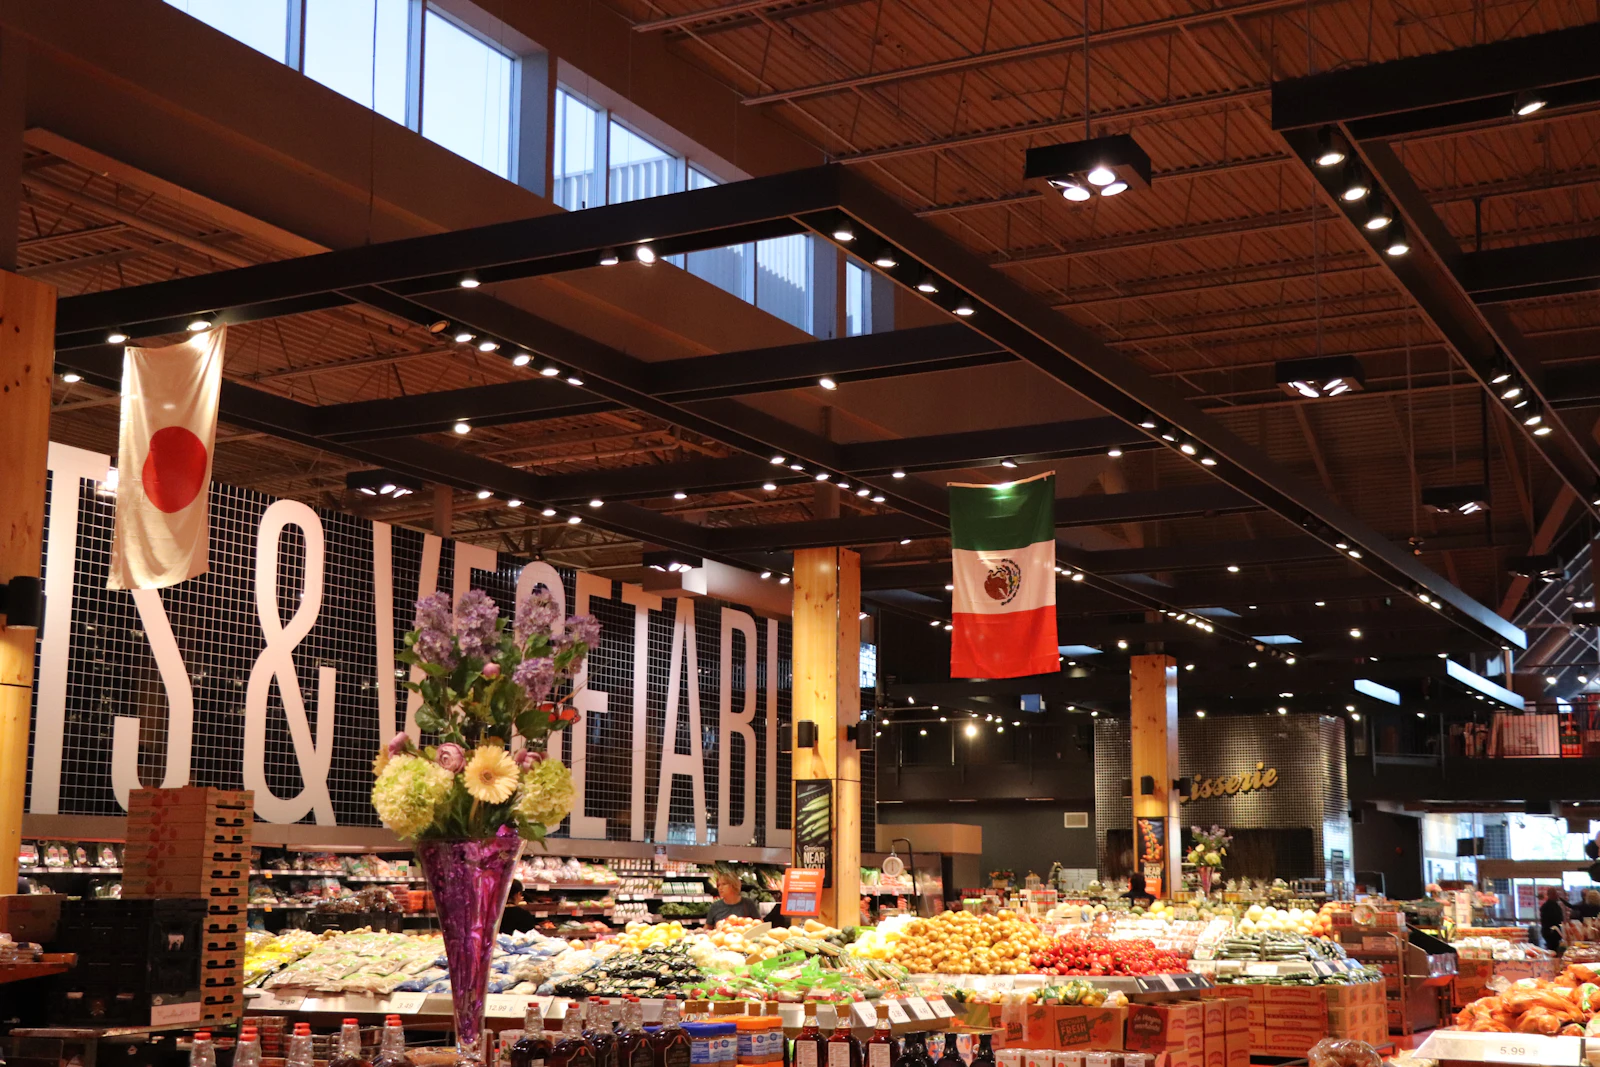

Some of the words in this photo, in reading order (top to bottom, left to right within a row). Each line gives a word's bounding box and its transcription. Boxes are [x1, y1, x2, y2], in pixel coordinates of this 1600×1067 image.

[242, 498, 338, 827] &
[1180, 761, 1279, 803] isserie
[803, 852, 826, 864] NEAR
[488, 1004, 508, 1012] 12.99
[1060, 1023, 1087, 1035] FRESH
[1500, 1046, 1526, 1056] 5.99
